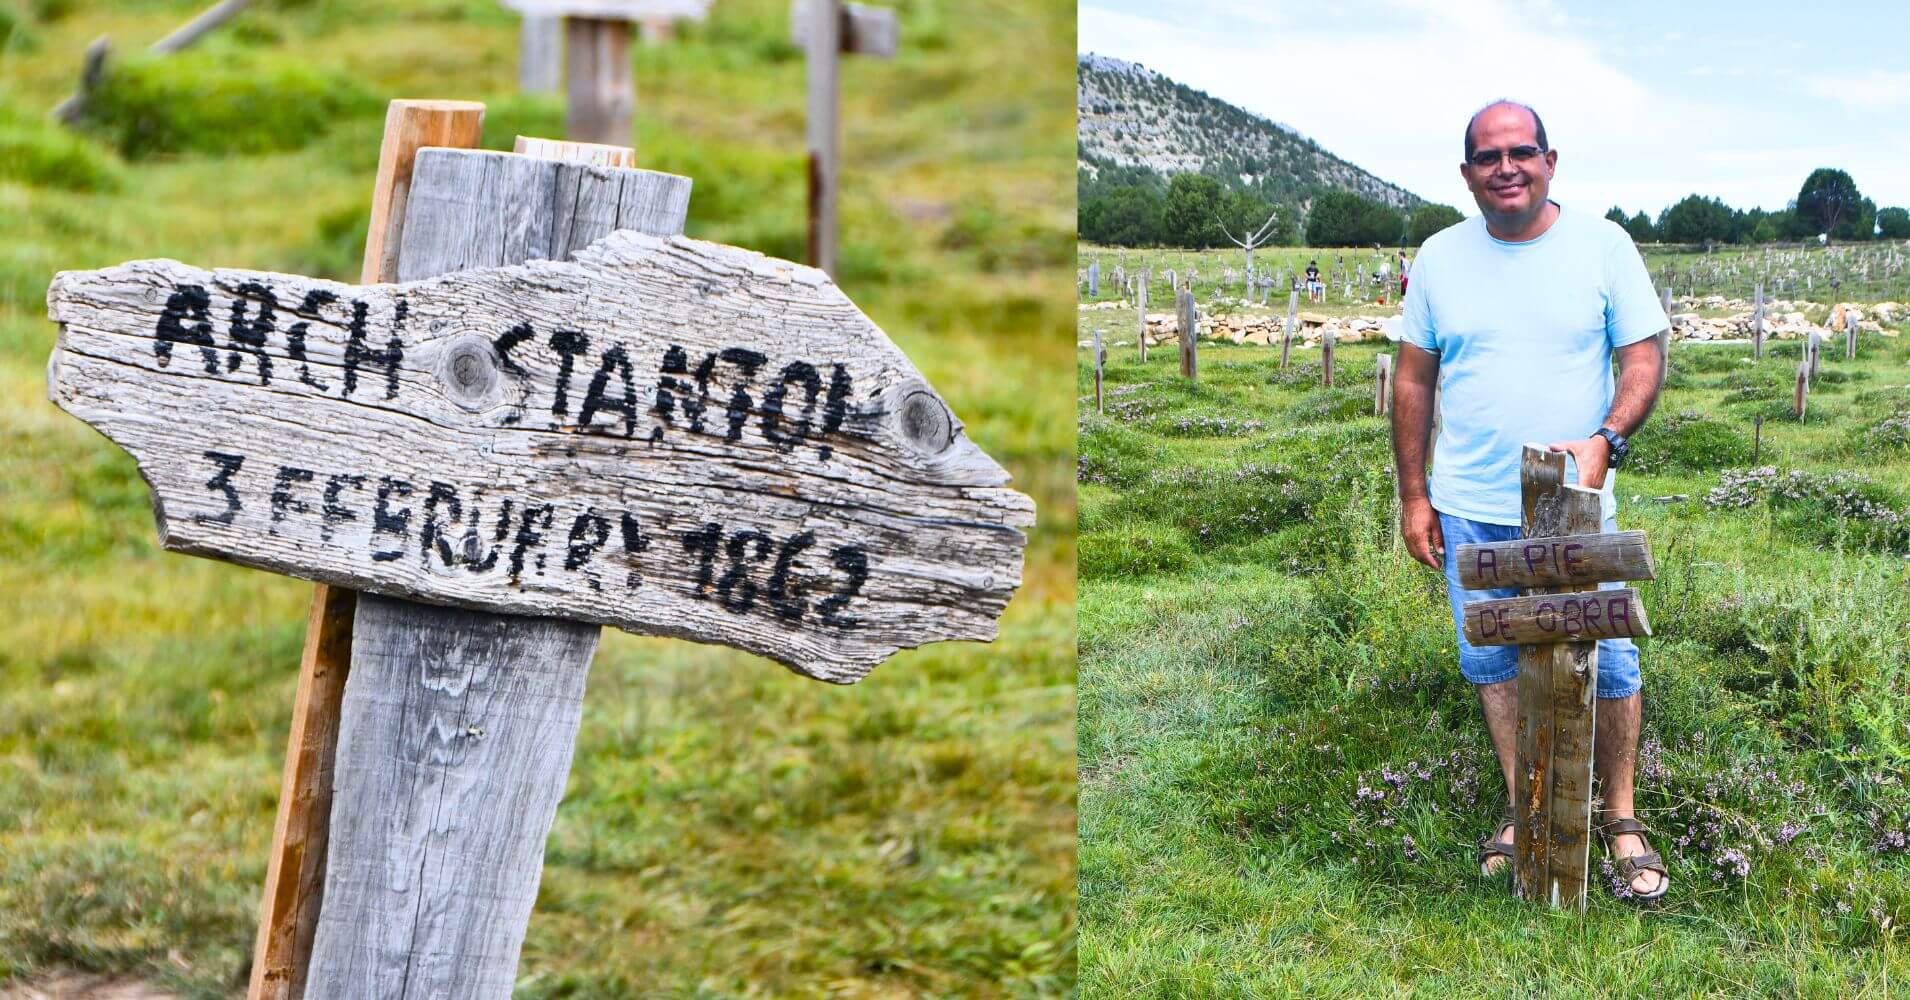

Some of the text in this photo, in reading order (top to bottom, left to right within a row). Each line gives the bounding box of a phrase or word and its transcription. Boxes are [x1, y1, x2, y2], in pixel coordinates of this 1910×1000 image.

[154, 283, 409, 399] ARCH
[195, 450, 245, 525] 3
[681, 522, 870, 630] 1862
[1477, 542, 1584, 580] A PIE
[1480, 597, 1633, 641] DE OBRA
